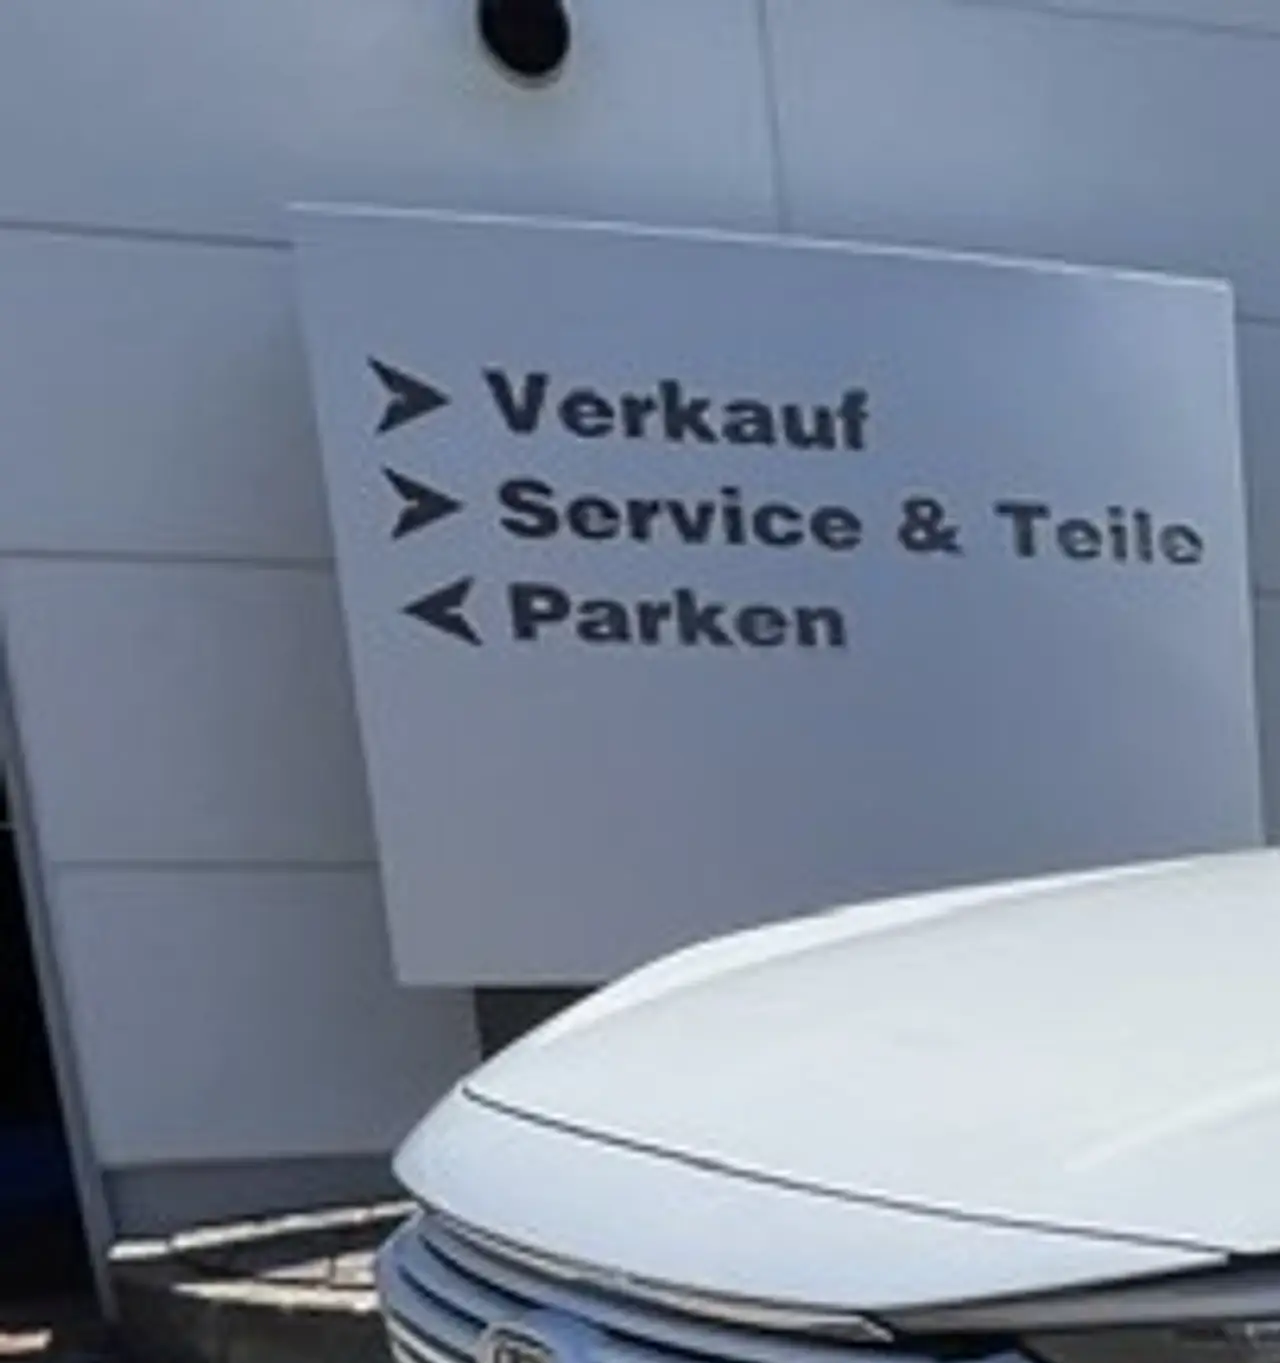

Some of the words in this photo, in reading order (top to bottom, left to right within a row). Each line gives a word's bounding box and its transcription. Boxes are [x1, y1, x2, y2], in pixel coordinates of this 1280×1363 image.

[483, 370, 869, 450] Verkauf
[497, 477, 862, 551] Service
[898, 498, 965, 555] &
[994, 502, 1205, 566] Teile
[508, 583, 846, 648] Parken
